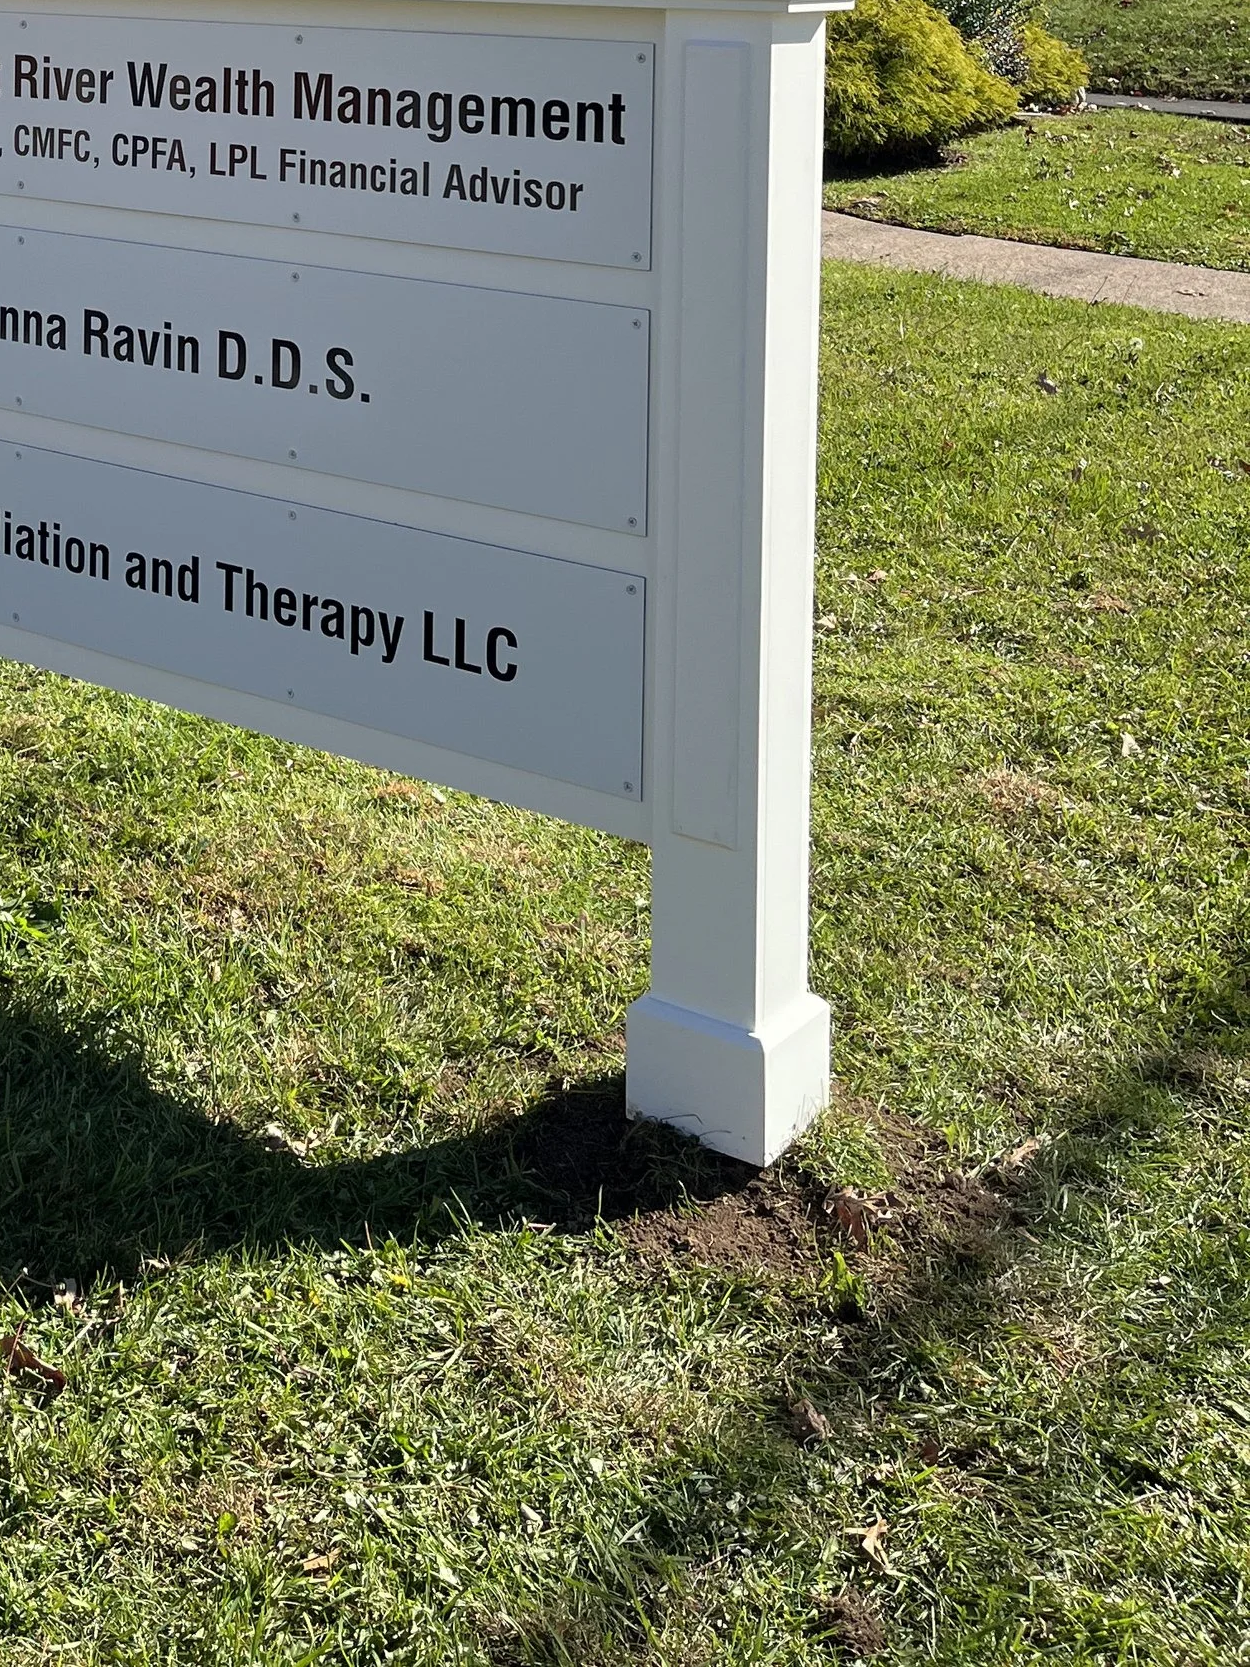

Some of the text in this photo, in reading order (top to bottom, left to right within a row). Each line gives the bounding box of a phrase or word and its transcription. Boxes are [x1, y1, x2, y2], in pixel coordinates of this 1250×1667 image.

[14, 53, 114, 105] River
[126, 60, 275, 118] Wealth
[293, 71, 627, 146] Management
[13, 124, 100, 169] CMFC,
[111, 133, 196, 179] CPFA,
[209, 141, 268, 181] LPL
[279, 147, 430, 197] Financial
[442, 163, 584, 212] Advisor
[83, 308, 200, 375] Ravin
[218, 329, 371, 404] D.D.S.
[124, 551, 200, 604] and
[215, 560, 405, 664] Therapy
[422, 609, 519, 683] LLC
